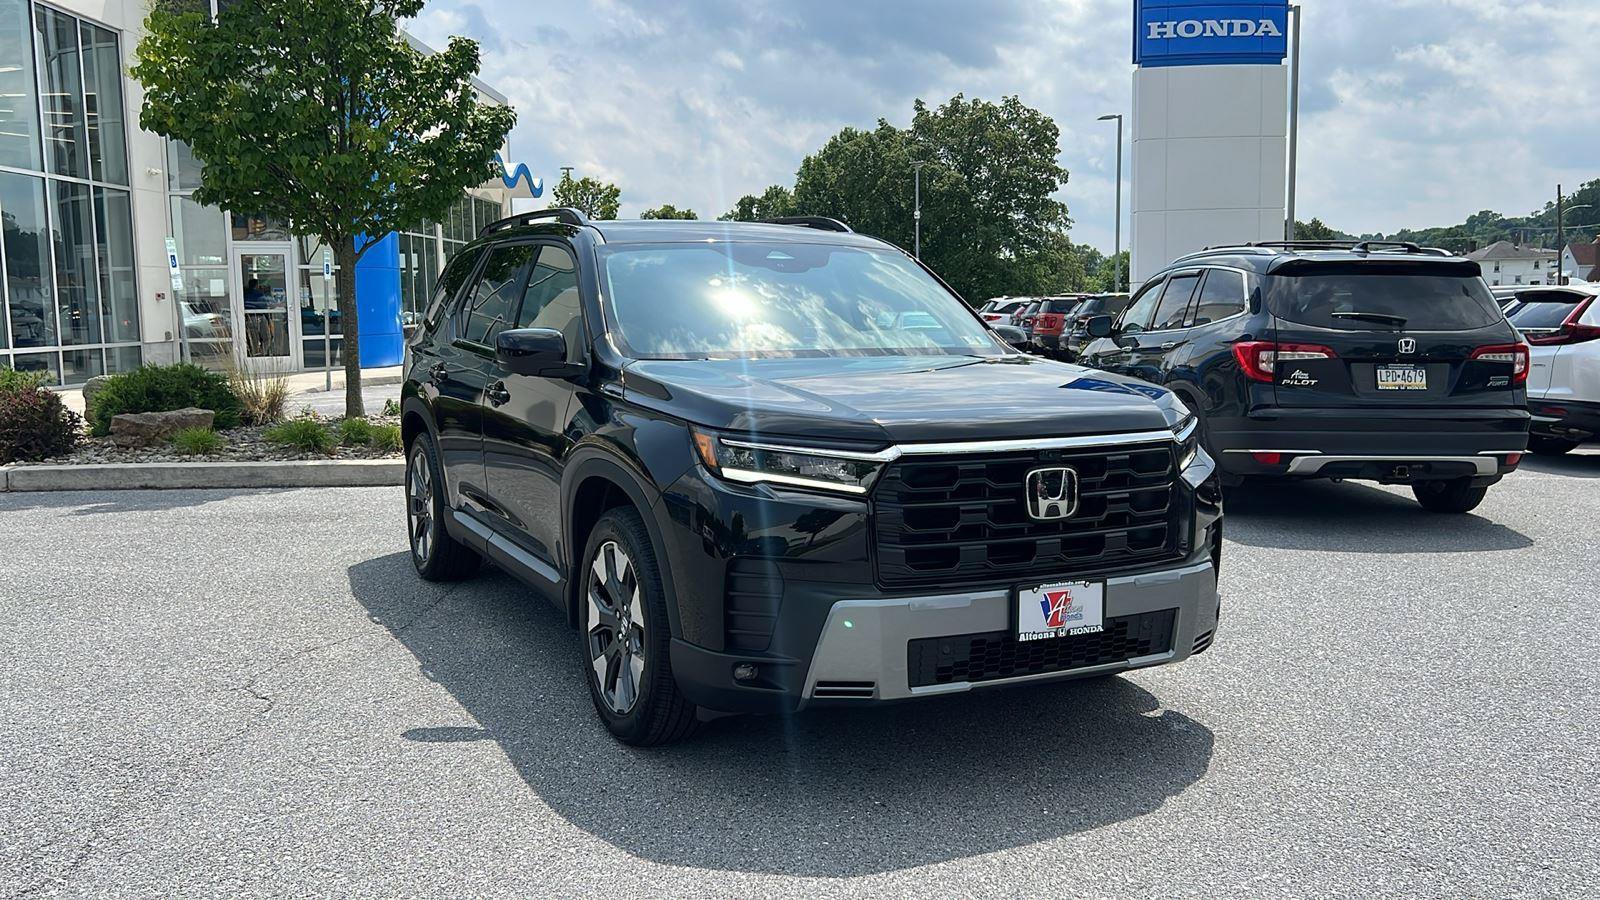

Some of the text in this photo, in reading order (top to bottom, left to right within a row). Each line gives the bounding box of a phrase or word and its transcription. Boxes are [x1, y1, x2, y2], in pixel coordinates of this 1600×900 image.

[1147, 19, 1282, 39] HONDA
[1019, 625, 1104, 642] Altoona HONDA
